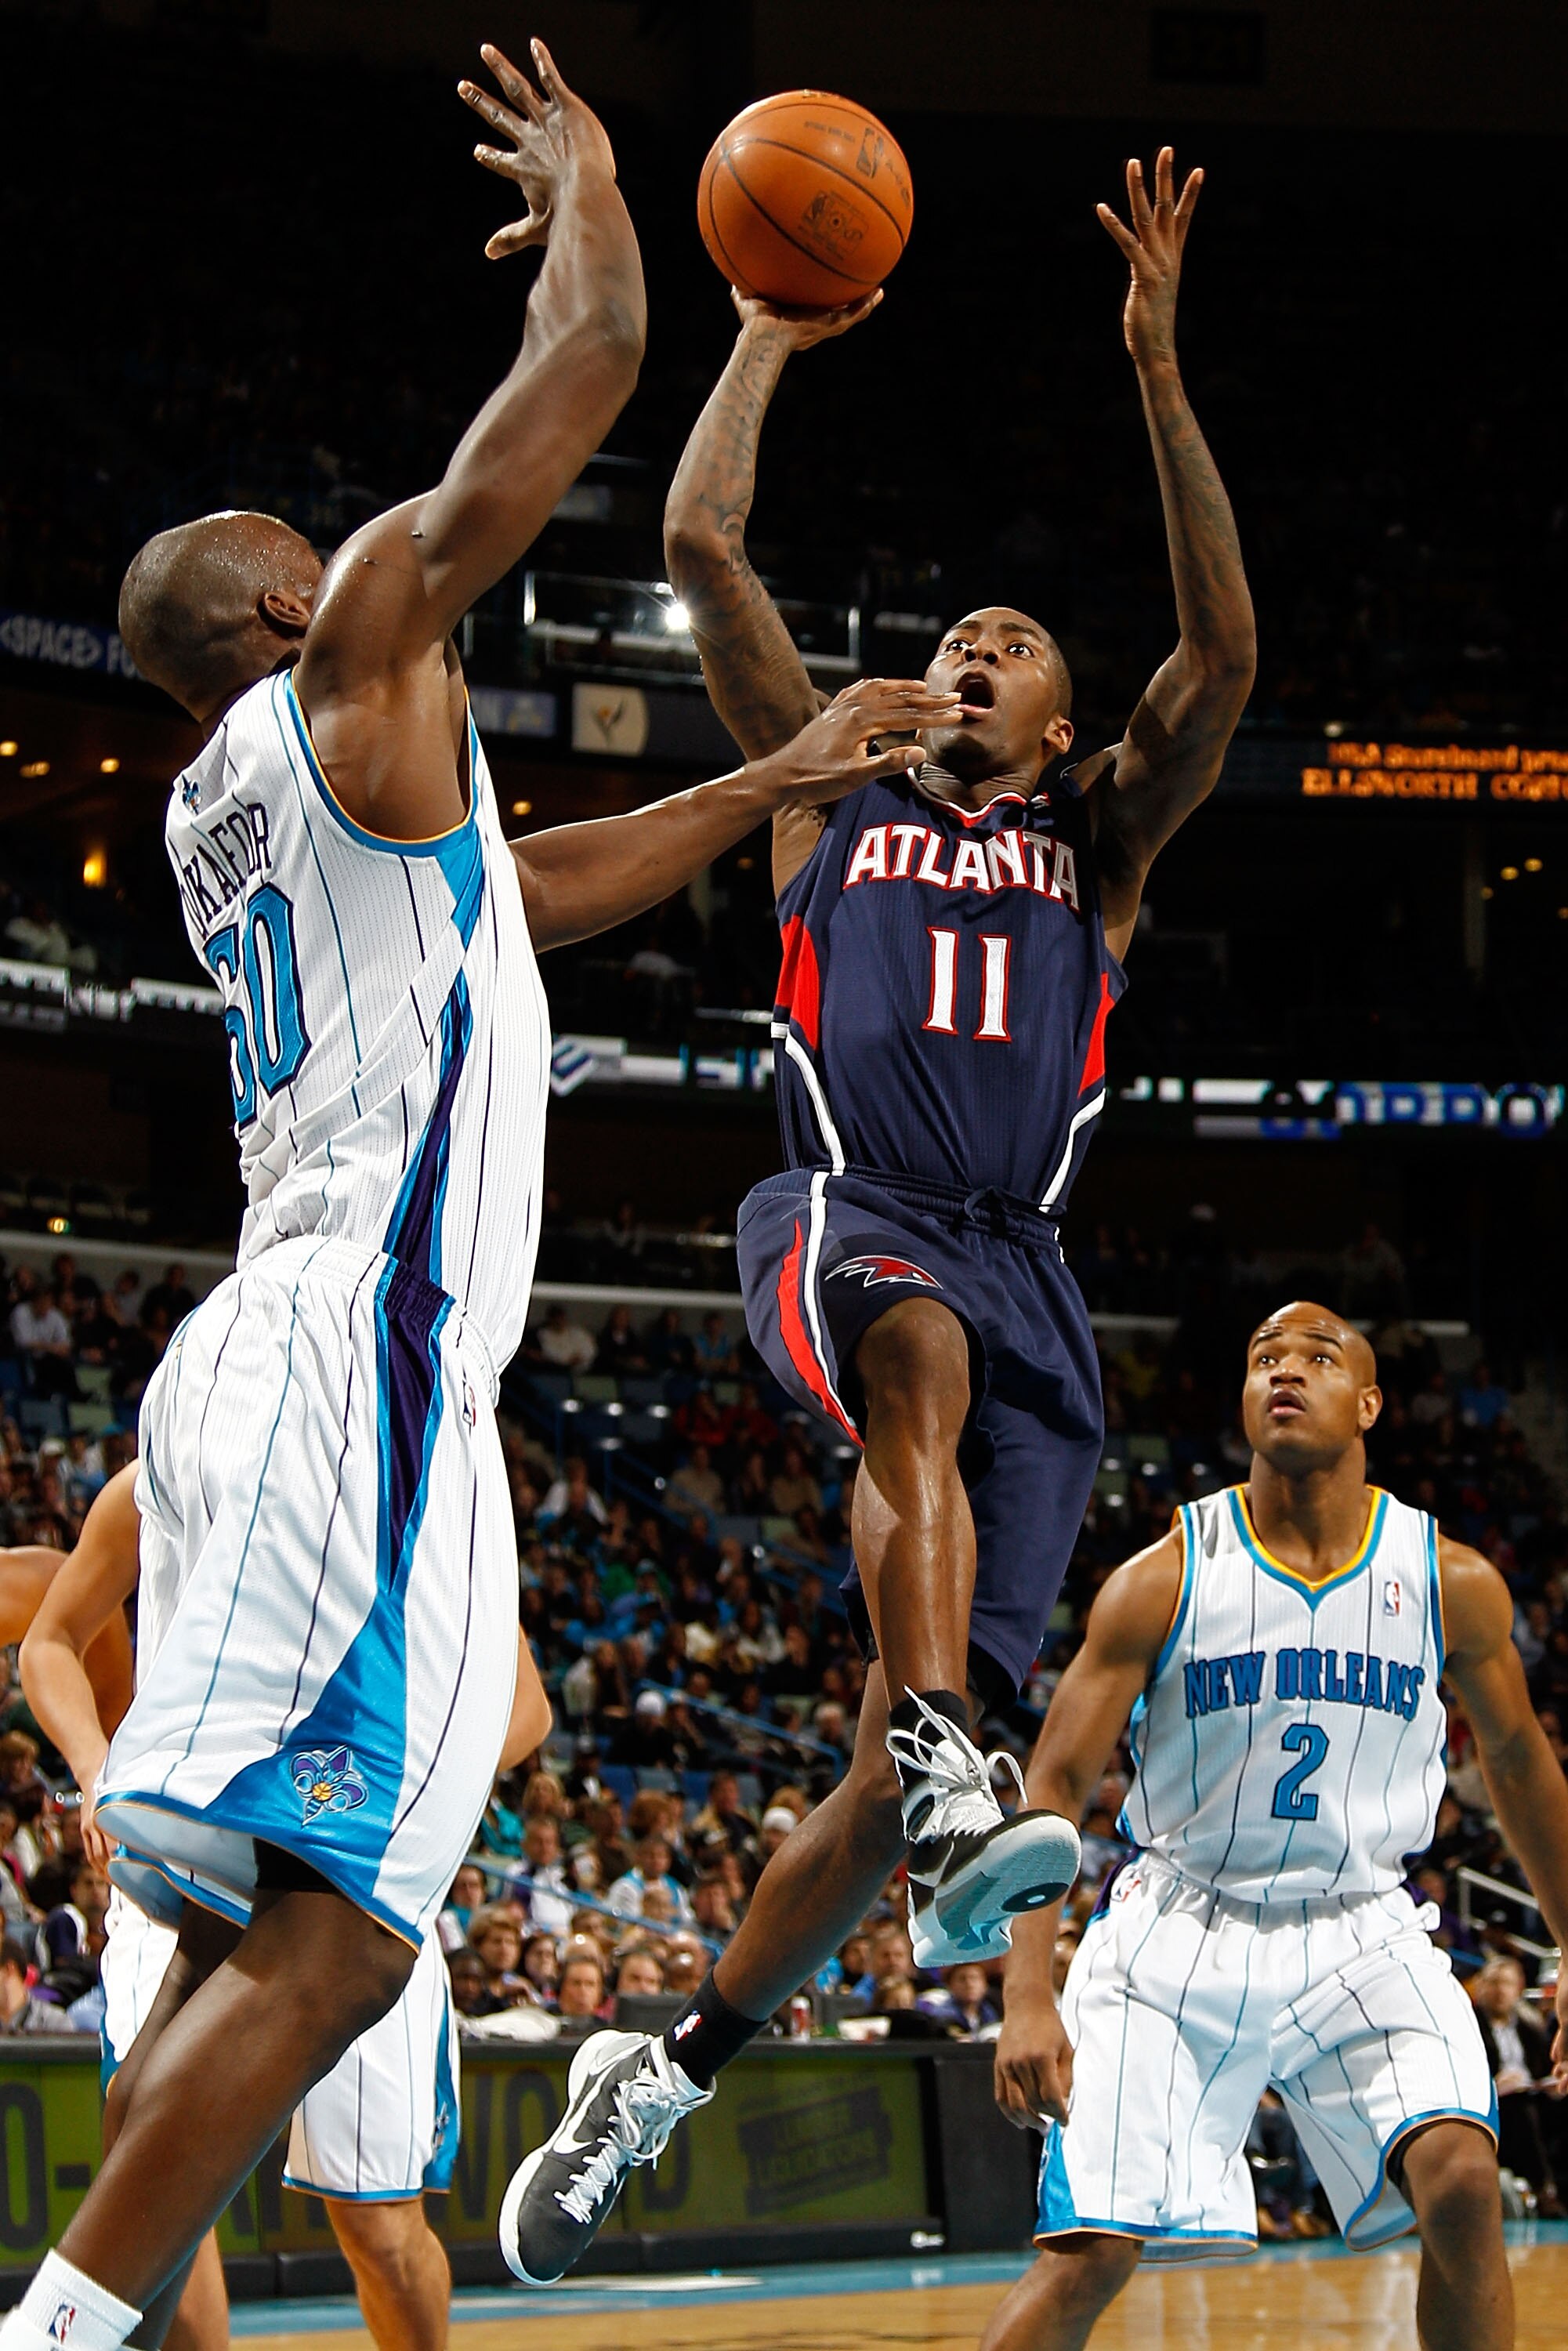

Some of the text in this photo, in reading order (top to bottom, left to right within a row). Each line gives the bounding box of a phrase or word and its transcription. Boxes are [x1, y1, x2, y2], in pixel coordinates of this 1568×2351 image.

[842, 822, 1082, 915] ATLANTA
[922, 926, 1012, 1043] 11
[1183, 1648, 1425, 1722] NEW ORLEANS
[1271, 1723, 1330, 1821] 2
